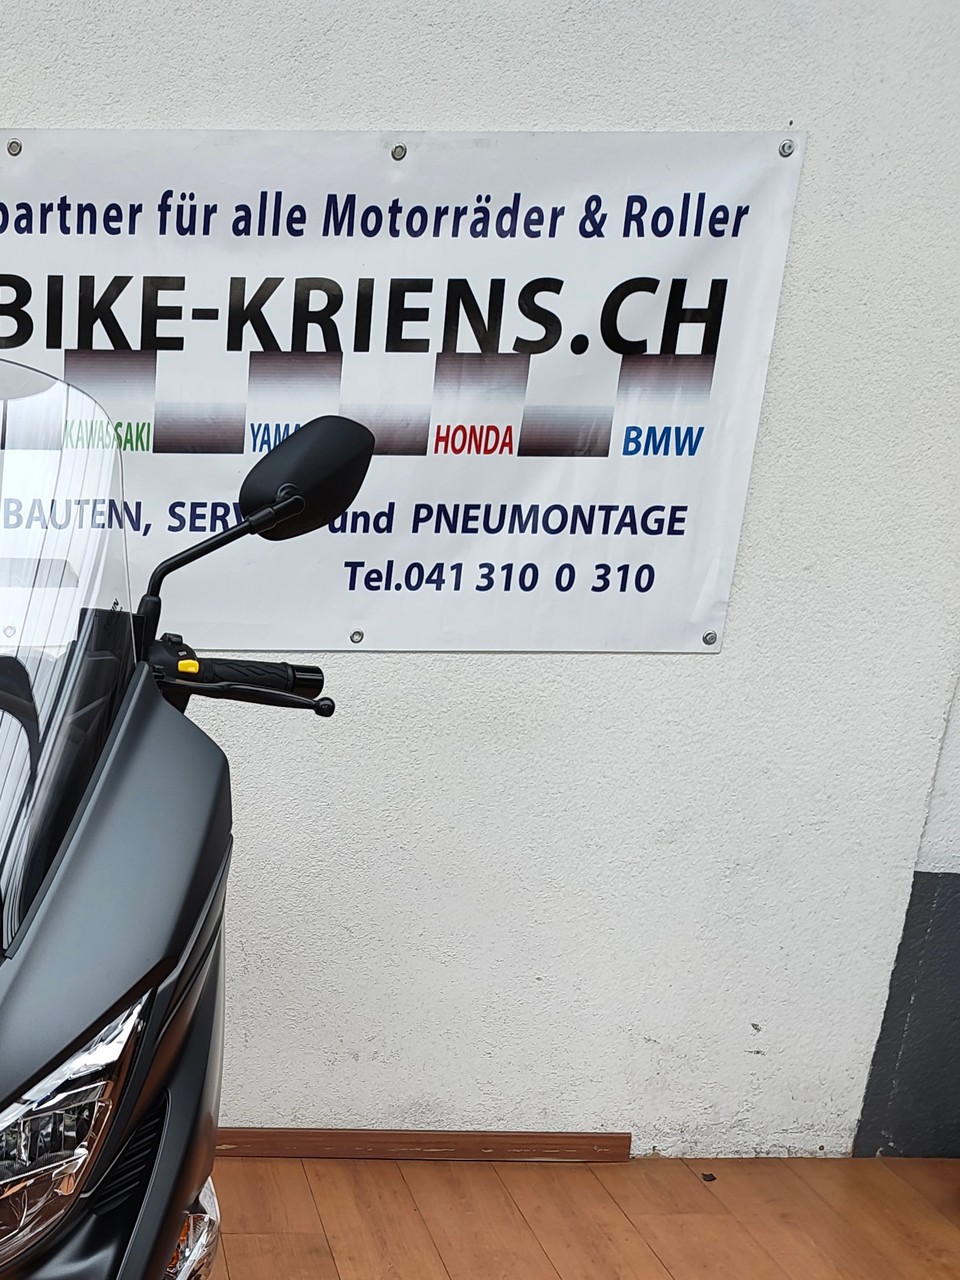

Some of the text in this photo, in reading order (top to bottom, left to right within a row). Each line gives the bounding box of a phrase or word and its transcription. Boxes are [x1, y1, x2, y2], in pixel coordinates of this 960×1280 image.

[158, 189, 217, 236] für
[231, 191, 307, 237] alle
[322, 192, 565, 238] Motorräder
[578, 194, 608, 239] &
[622, 192, 750, 238] Roller
[434, 424, 514, 455] HONDA
[622, 426, 705, 456] BMW
[328, 502, 395, 534] und
[411, 503, 688, 535] PNEUMONTAGE
[344, 560, 656, 593] Tel.041 310 0 310
